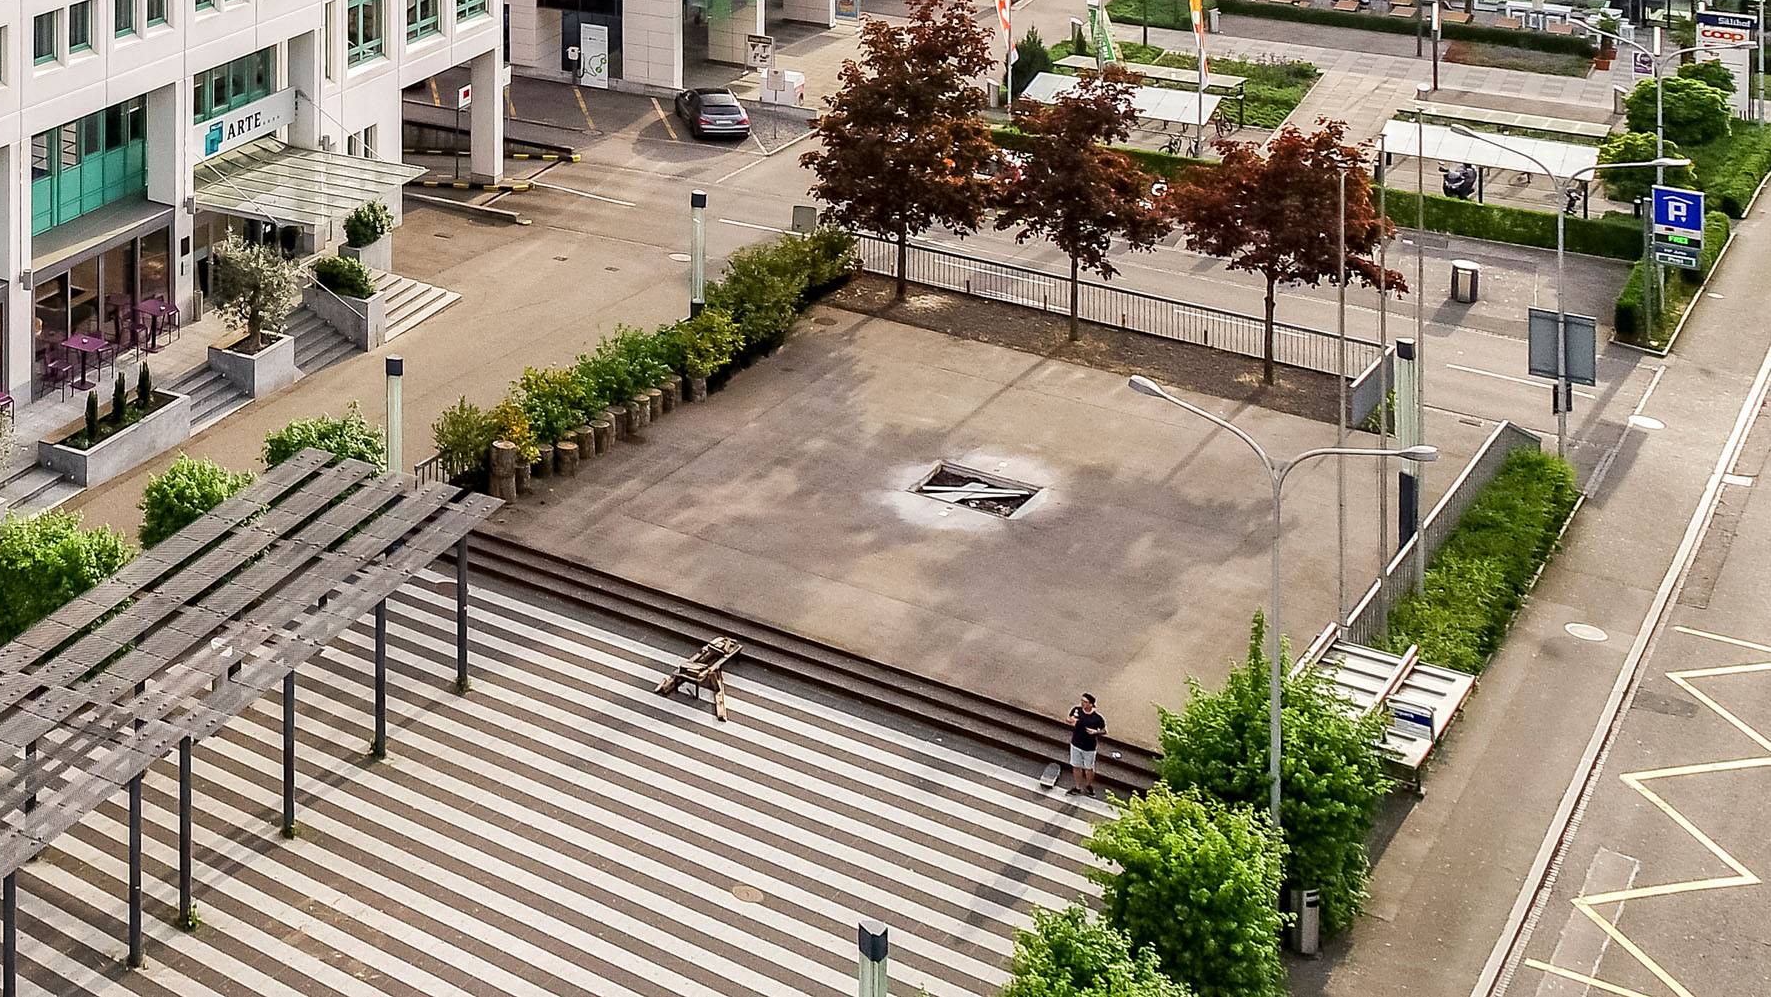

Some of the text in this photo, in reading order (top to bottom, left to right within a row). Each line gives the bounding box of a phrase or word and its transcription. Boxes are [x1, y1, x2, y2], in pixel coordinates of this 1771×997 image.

[1701, 29, 1745, 42] coop
[227, 112, 262, 140] ARTE
[1668, 201, 1687, 222] P
